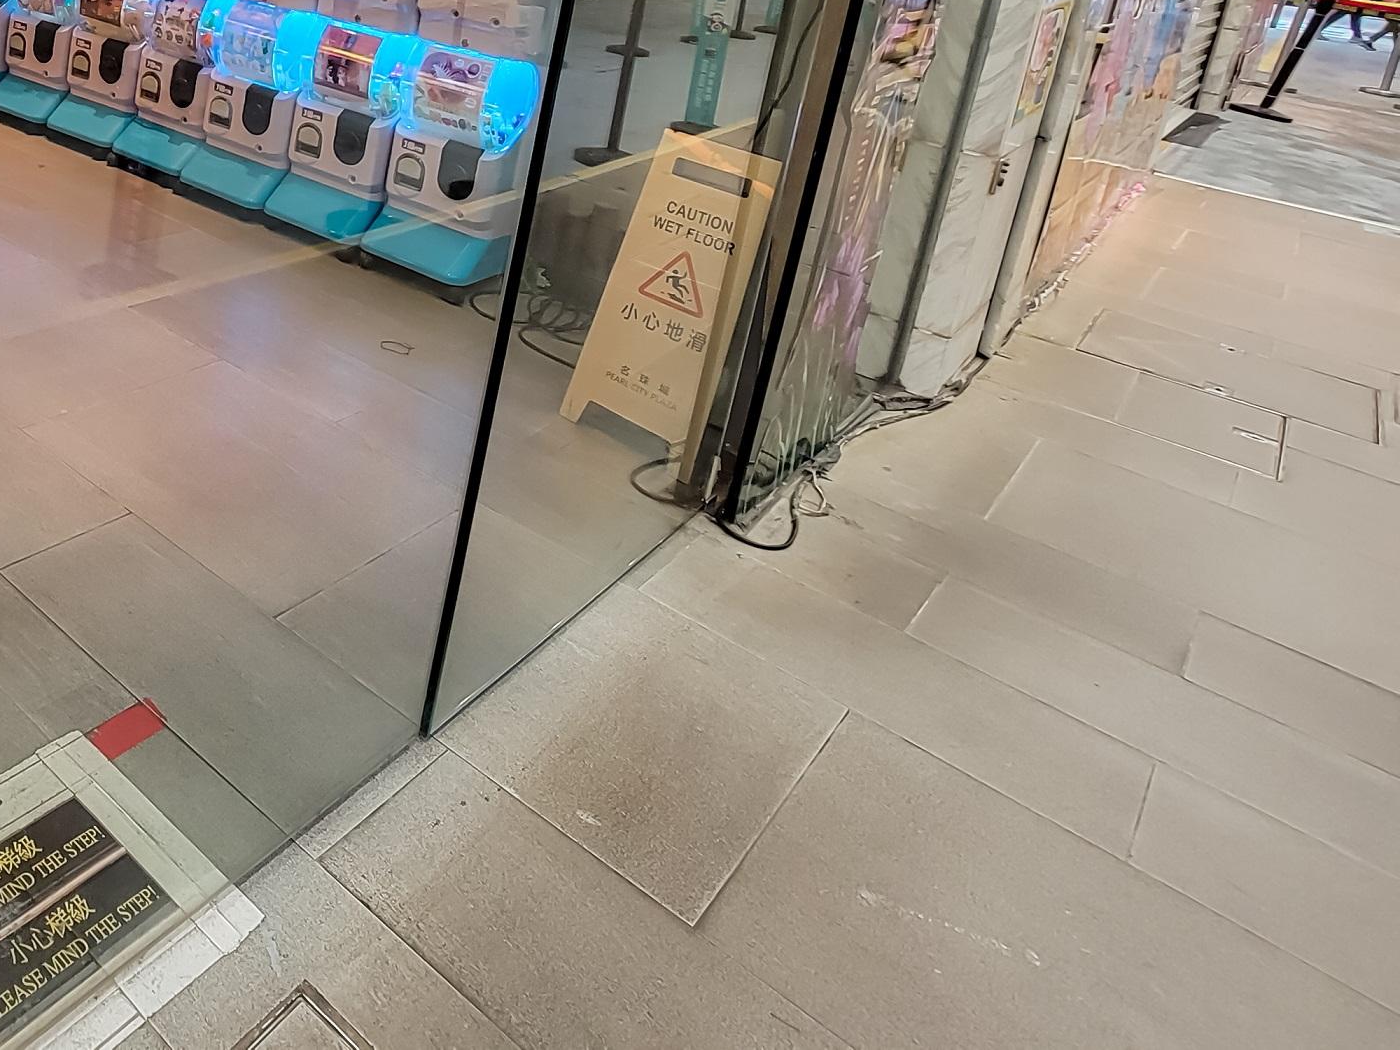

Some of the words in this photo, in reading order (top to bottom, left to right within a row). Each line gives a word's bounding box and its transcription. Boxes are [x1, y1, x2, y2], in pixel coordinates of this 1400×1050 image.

[653, 215, 683, 236] WET
[685, 228, 736, 256] FLOOR
[666, 200, 734, 234] CAUTION
[621, 302, 708, 353] 小心地滑
[605, 370, 628, 388] PEARL
[32, 850, 68, 879] THE
[63, 825, 106, 858] STEP!
[9, 894, 96, 965] 小心梯級
[42, 937, 90, 979] MIND
[85, 913, 123, 945] THE
[116, 884, 161, 923] STEP!
